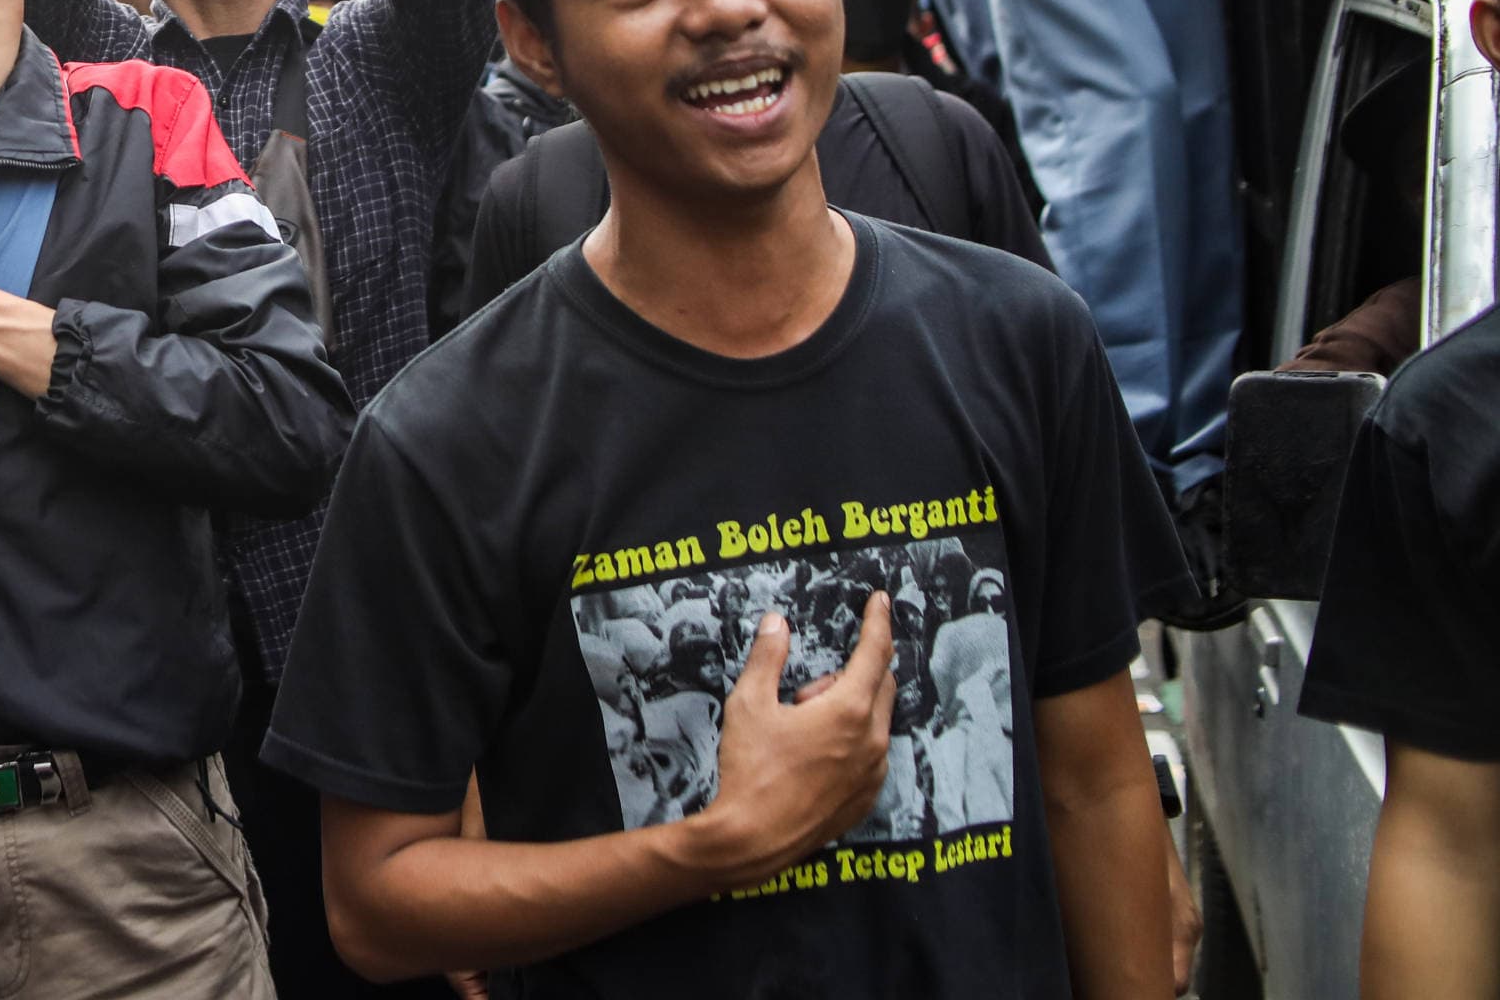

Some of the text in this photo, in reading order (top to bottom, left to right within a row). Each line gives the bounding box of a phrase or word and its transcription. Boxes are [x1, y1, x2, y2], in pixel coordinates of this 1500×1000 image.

[571, 485, 998, 590] Zaman Boleh Berganti
[836, 848, 925, 883] Tetep
[934, 825, 1013, 873] Lestari
